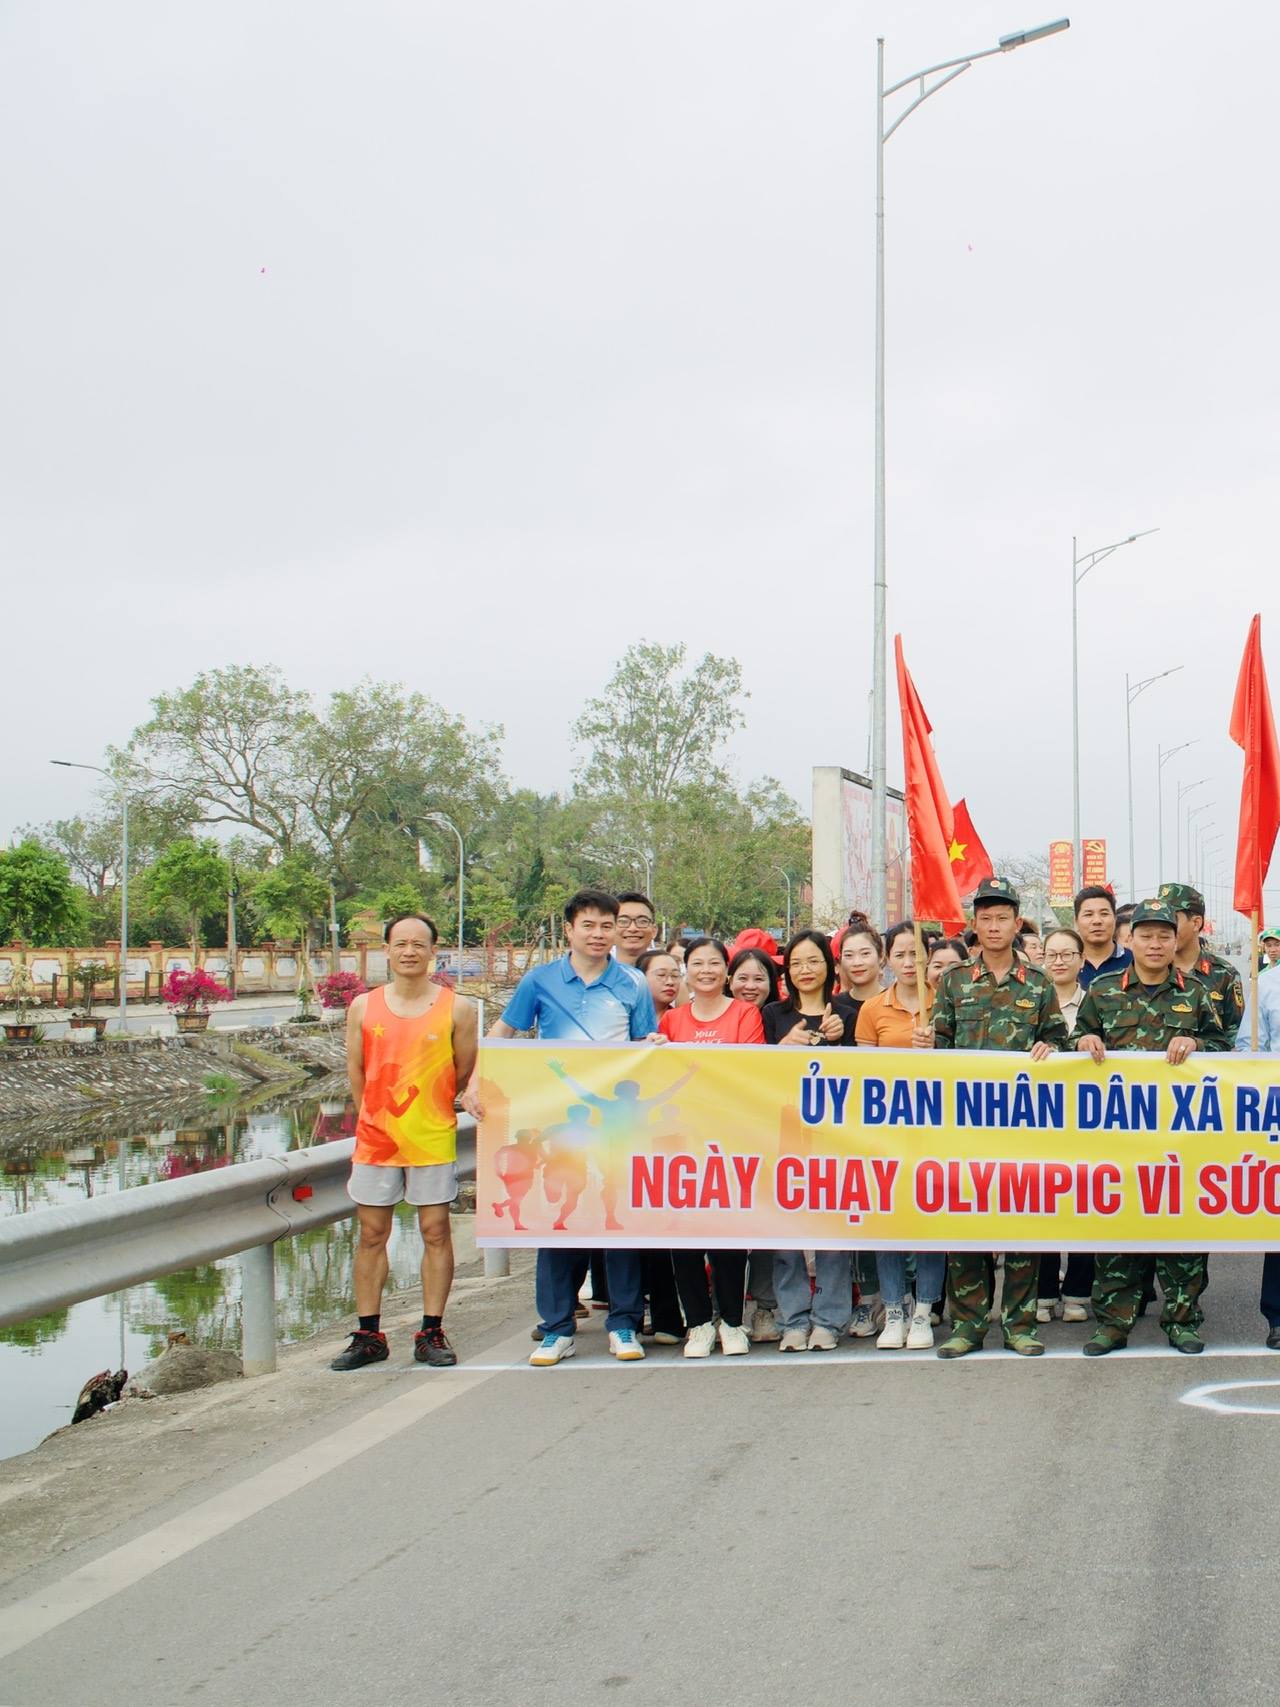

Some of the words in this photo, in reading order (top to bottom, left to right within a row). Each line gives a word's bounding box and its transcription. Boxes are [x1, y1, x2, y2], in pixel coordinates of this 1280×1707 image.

[801, 1062, 848, 1125] ỦY
[863, 1078, 941, 1126] BAN
[956, 1073, 1064, 1129] NHÂN
[1078, 1074, 1157, 1131] DÂN
[1171, 1075, 1223, 1132] XÃ
[632, 1144, 759, 1208] NGÀY
[777, 1157, 898, 1223] CHẠY
[916, 1161, 1121, 1214] OLYMPIC
[1138, 1154, 1180, 1214] VÌ
